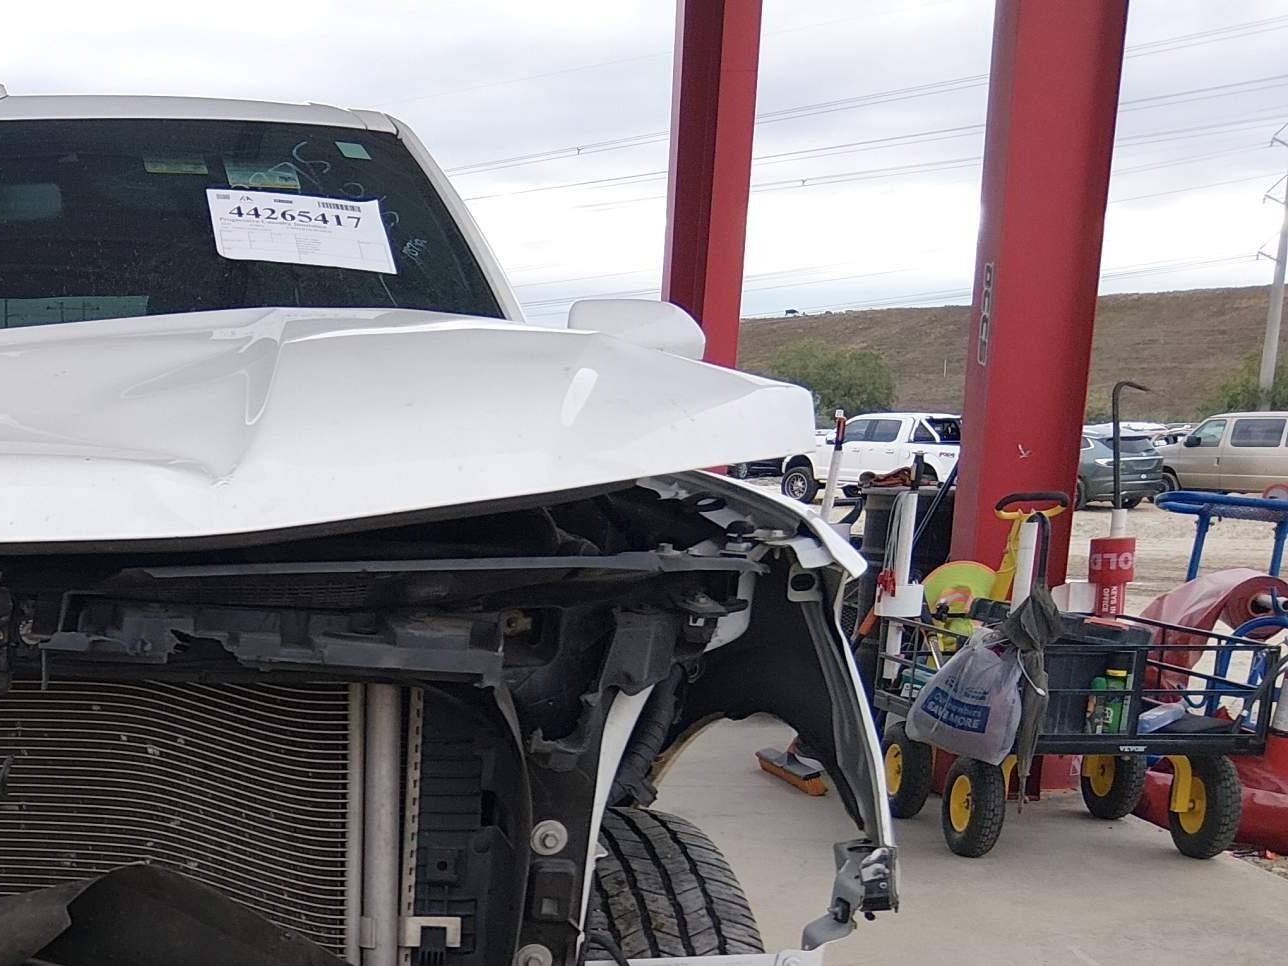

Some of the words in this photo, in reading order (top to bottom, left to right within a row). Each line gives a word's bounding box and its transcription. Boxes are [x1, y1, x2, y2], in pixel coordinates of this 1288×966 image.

[229, 205, 361, 229] 44265417
[1102, 587, 1110, 612] OFFICE
[1110, 585, 1118, 604] KEYS
